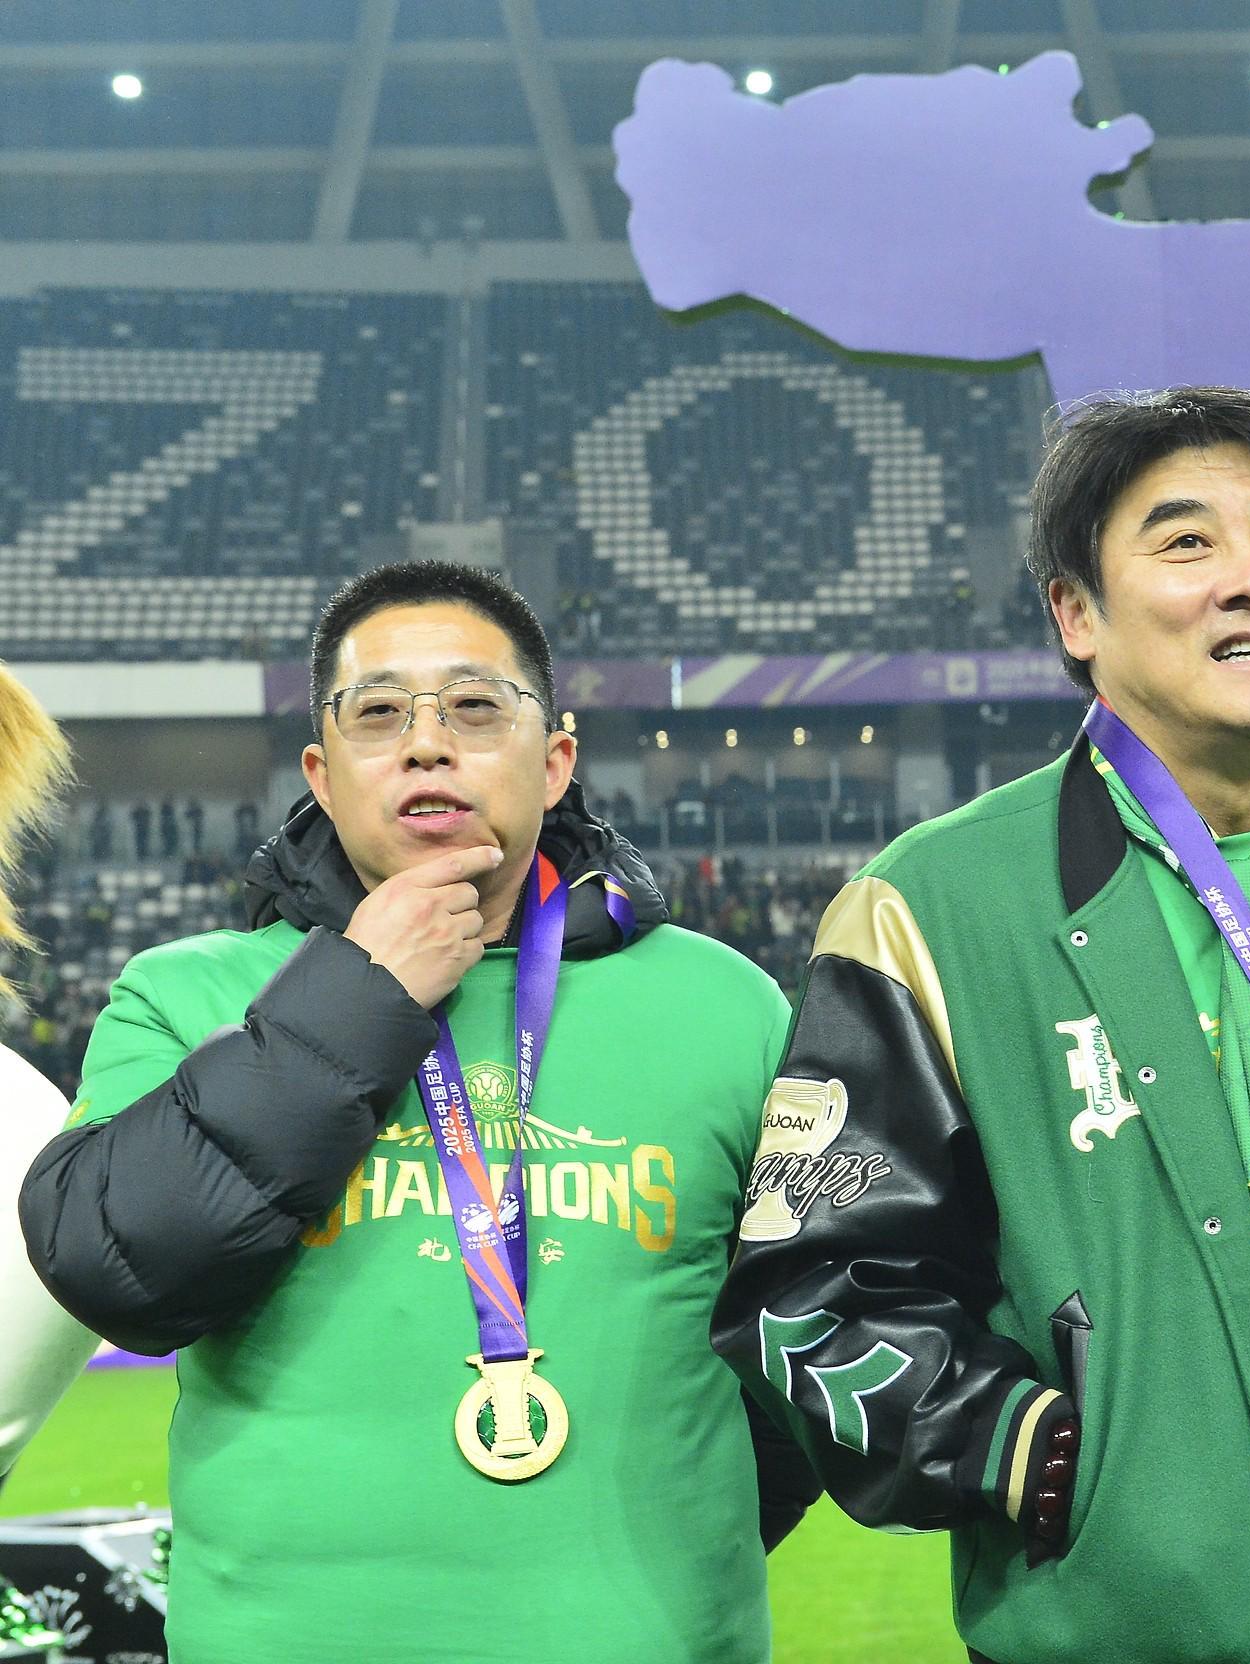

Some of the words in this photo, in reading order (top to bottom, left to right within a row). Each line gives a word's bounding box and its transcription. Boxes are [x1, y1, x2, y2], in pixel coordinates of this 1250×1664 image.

[1088, 1025, 1116, 1116] Champions
[422, 1050, 463, 1157] 2025中国足协
[448, 1082, 463, 1104] CUP
[456, 1105, 468, 1127] CFA
[470, 1102, 506, 1112] GUOAN
[763, 1113, 815, 1132] GUOAN
[461, 1128, 477, 1154] 2025
